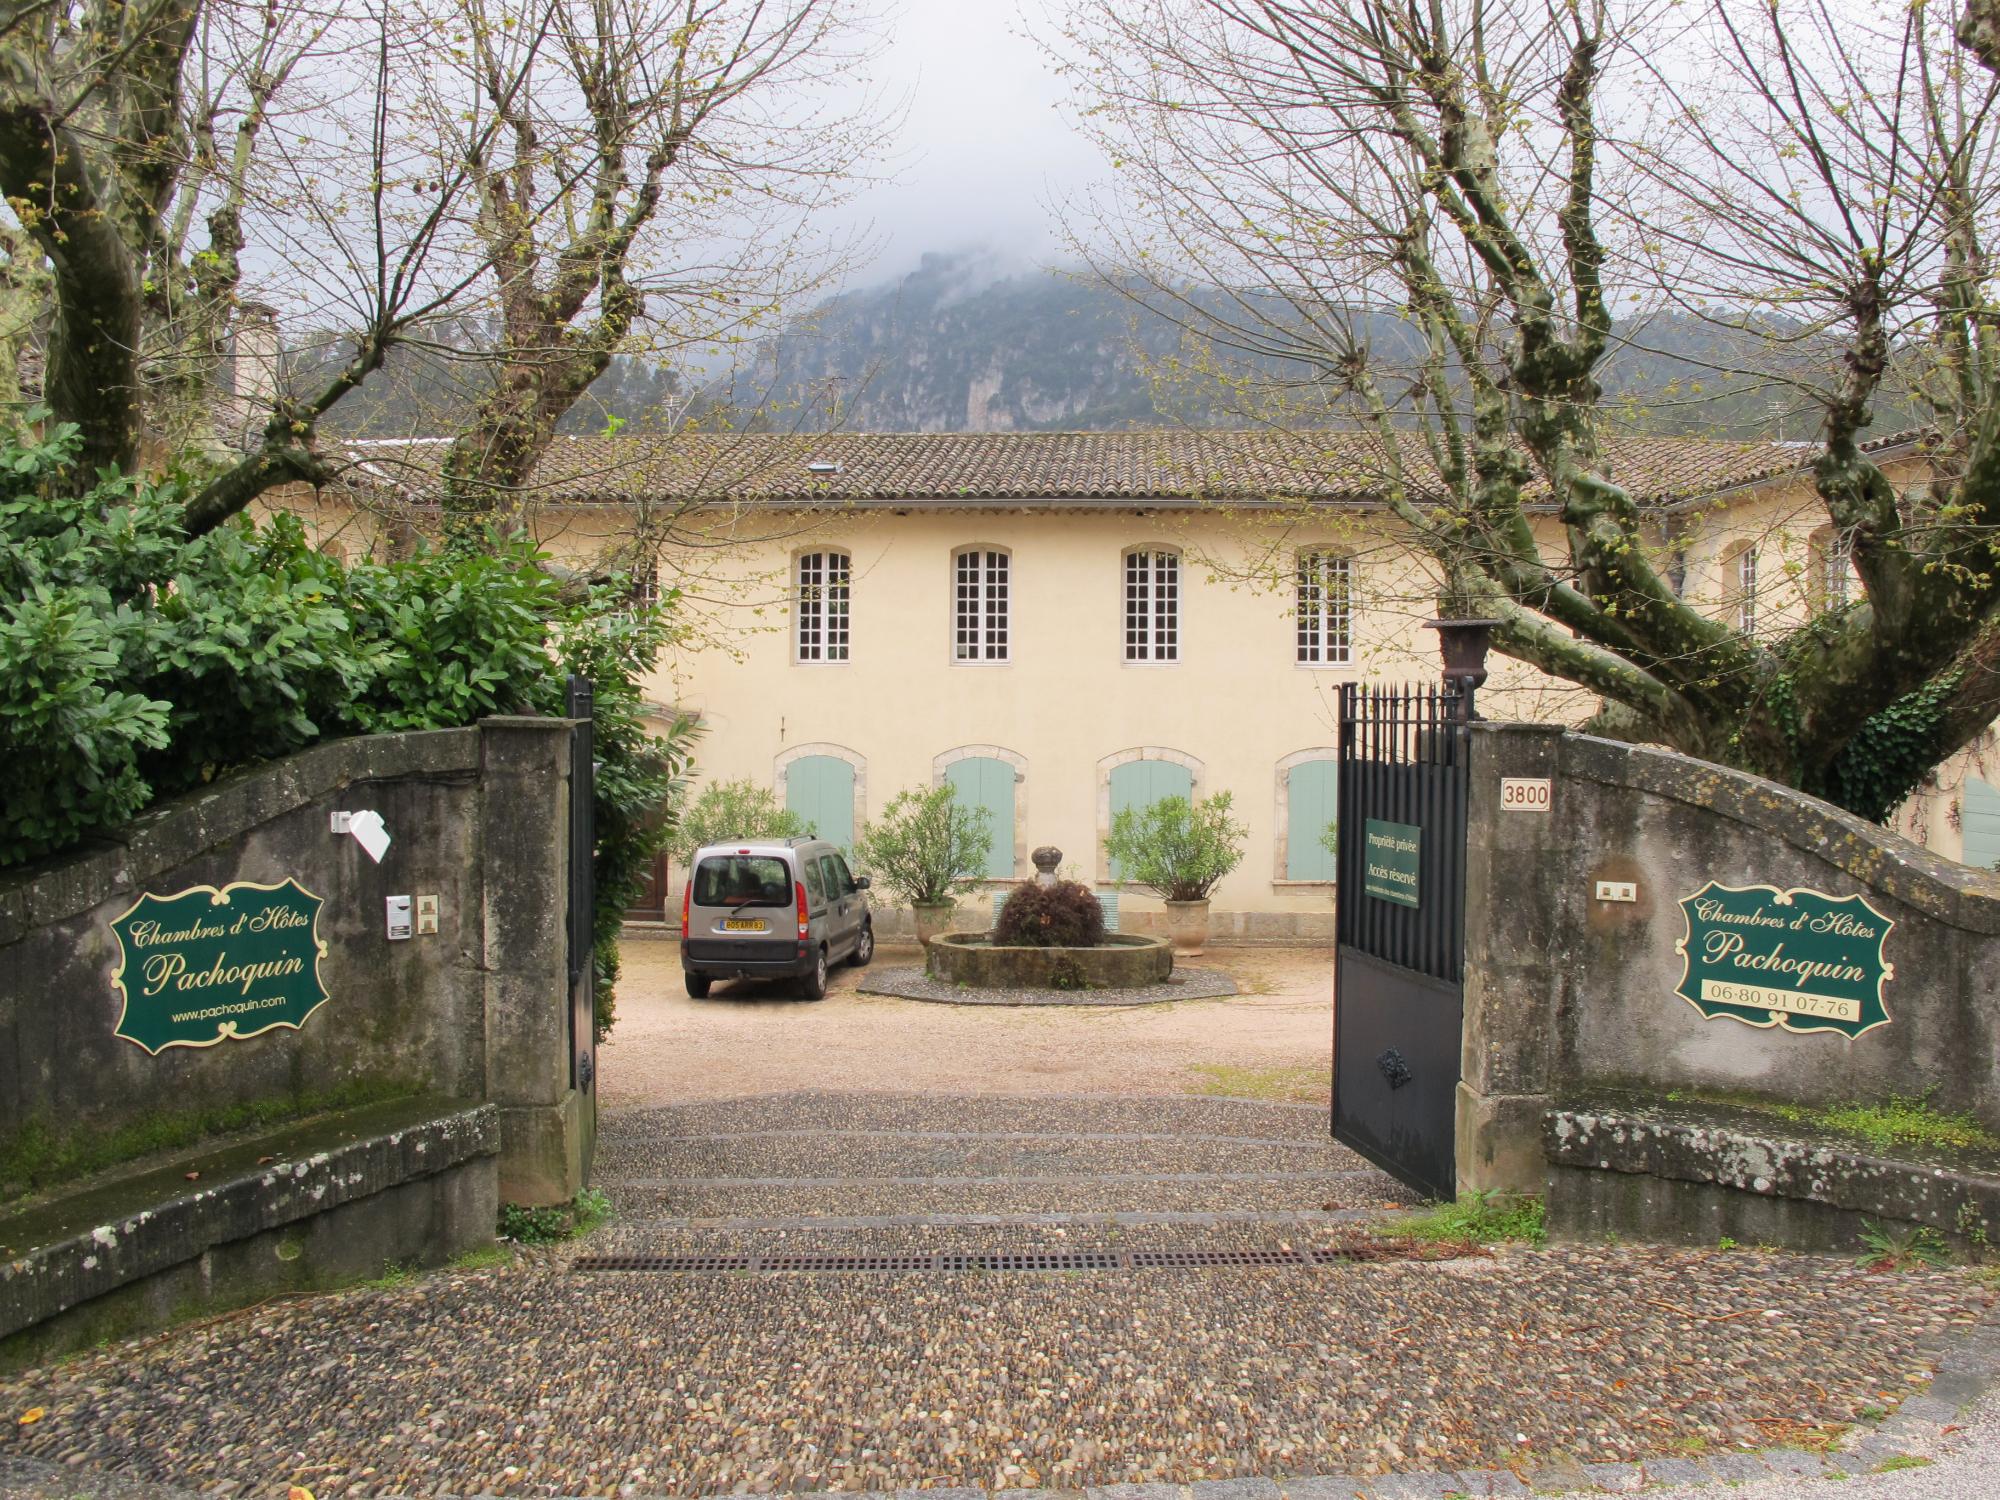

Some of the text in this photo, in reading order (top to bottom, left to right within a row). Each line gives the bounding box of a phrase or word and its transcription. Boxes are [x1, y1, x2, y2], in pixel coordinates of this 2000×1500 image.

[1505, 786, 1548, 804] 3800
[1396, 838, 1417, 852] privée
[1368, 863, 1416, 886] Accès réservé
[129, 905, 309, 949] Chambres d' Hôtes
[1694, 898, 1875, 939] Chambres d' Hôtes
[1703, 929, 1865, 987] Pachoquin
[142, 950, 304, 996] Pachoquin
[172, 996, 286, 1022] www.pachoquin.com
[1767, 992, 1787, 1008] 91
